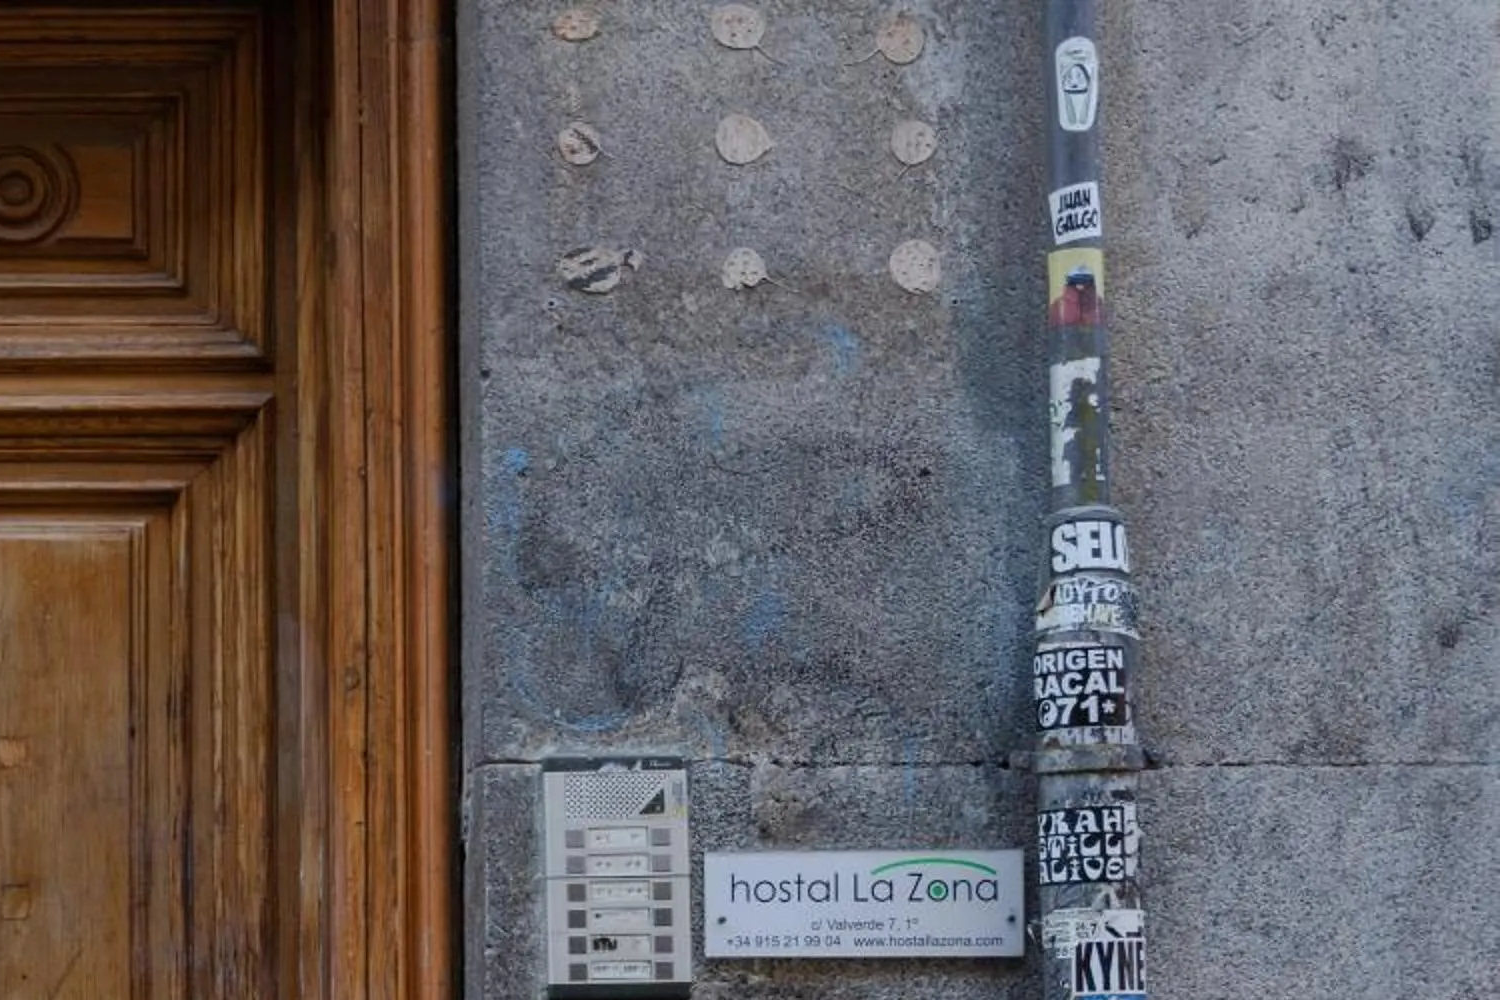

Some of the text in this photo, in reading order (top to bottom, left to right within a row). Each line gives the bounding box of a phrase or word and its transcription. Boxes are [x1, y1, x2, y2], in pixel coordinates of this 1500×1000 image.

[730, 872, 998, 903] hostal La Zona
[826, 918, 885, 931] Valverde
[853, 934, 1004, 947] www.hostallazona.com
